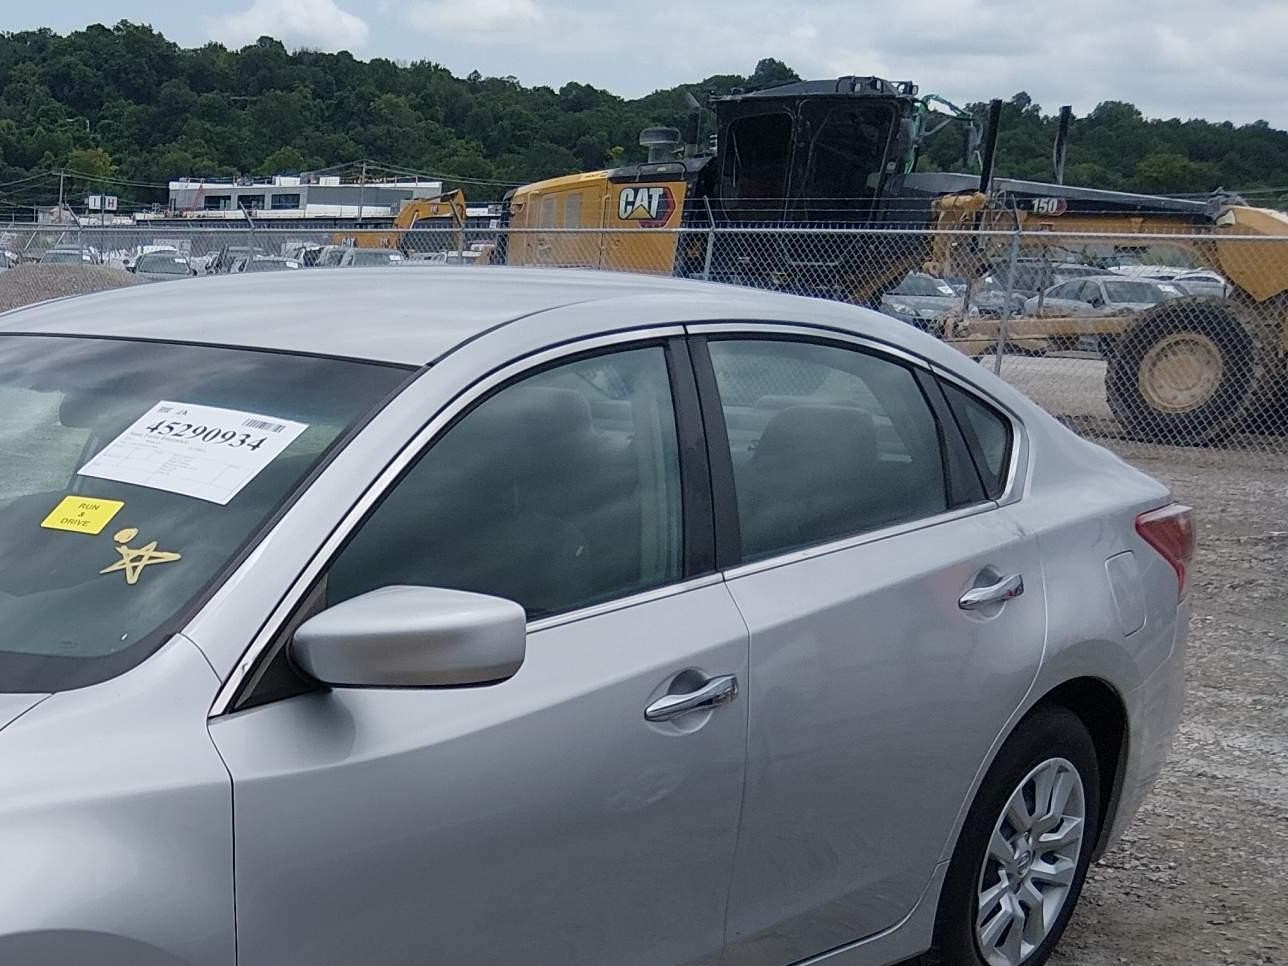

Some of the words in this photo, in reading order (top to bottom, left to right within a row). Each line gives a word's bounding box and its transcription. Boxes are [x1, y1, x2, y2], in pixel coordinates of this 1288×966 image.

[108, 198, 115, 208] H
[619, 188, 663, 219] CAT
[1032, 197, 1058, 214] 150
[145, 419, 268, 451] 45290934
[78, 503, 101, 511] RUN
[60, 517, 91, 528] DRIVE
